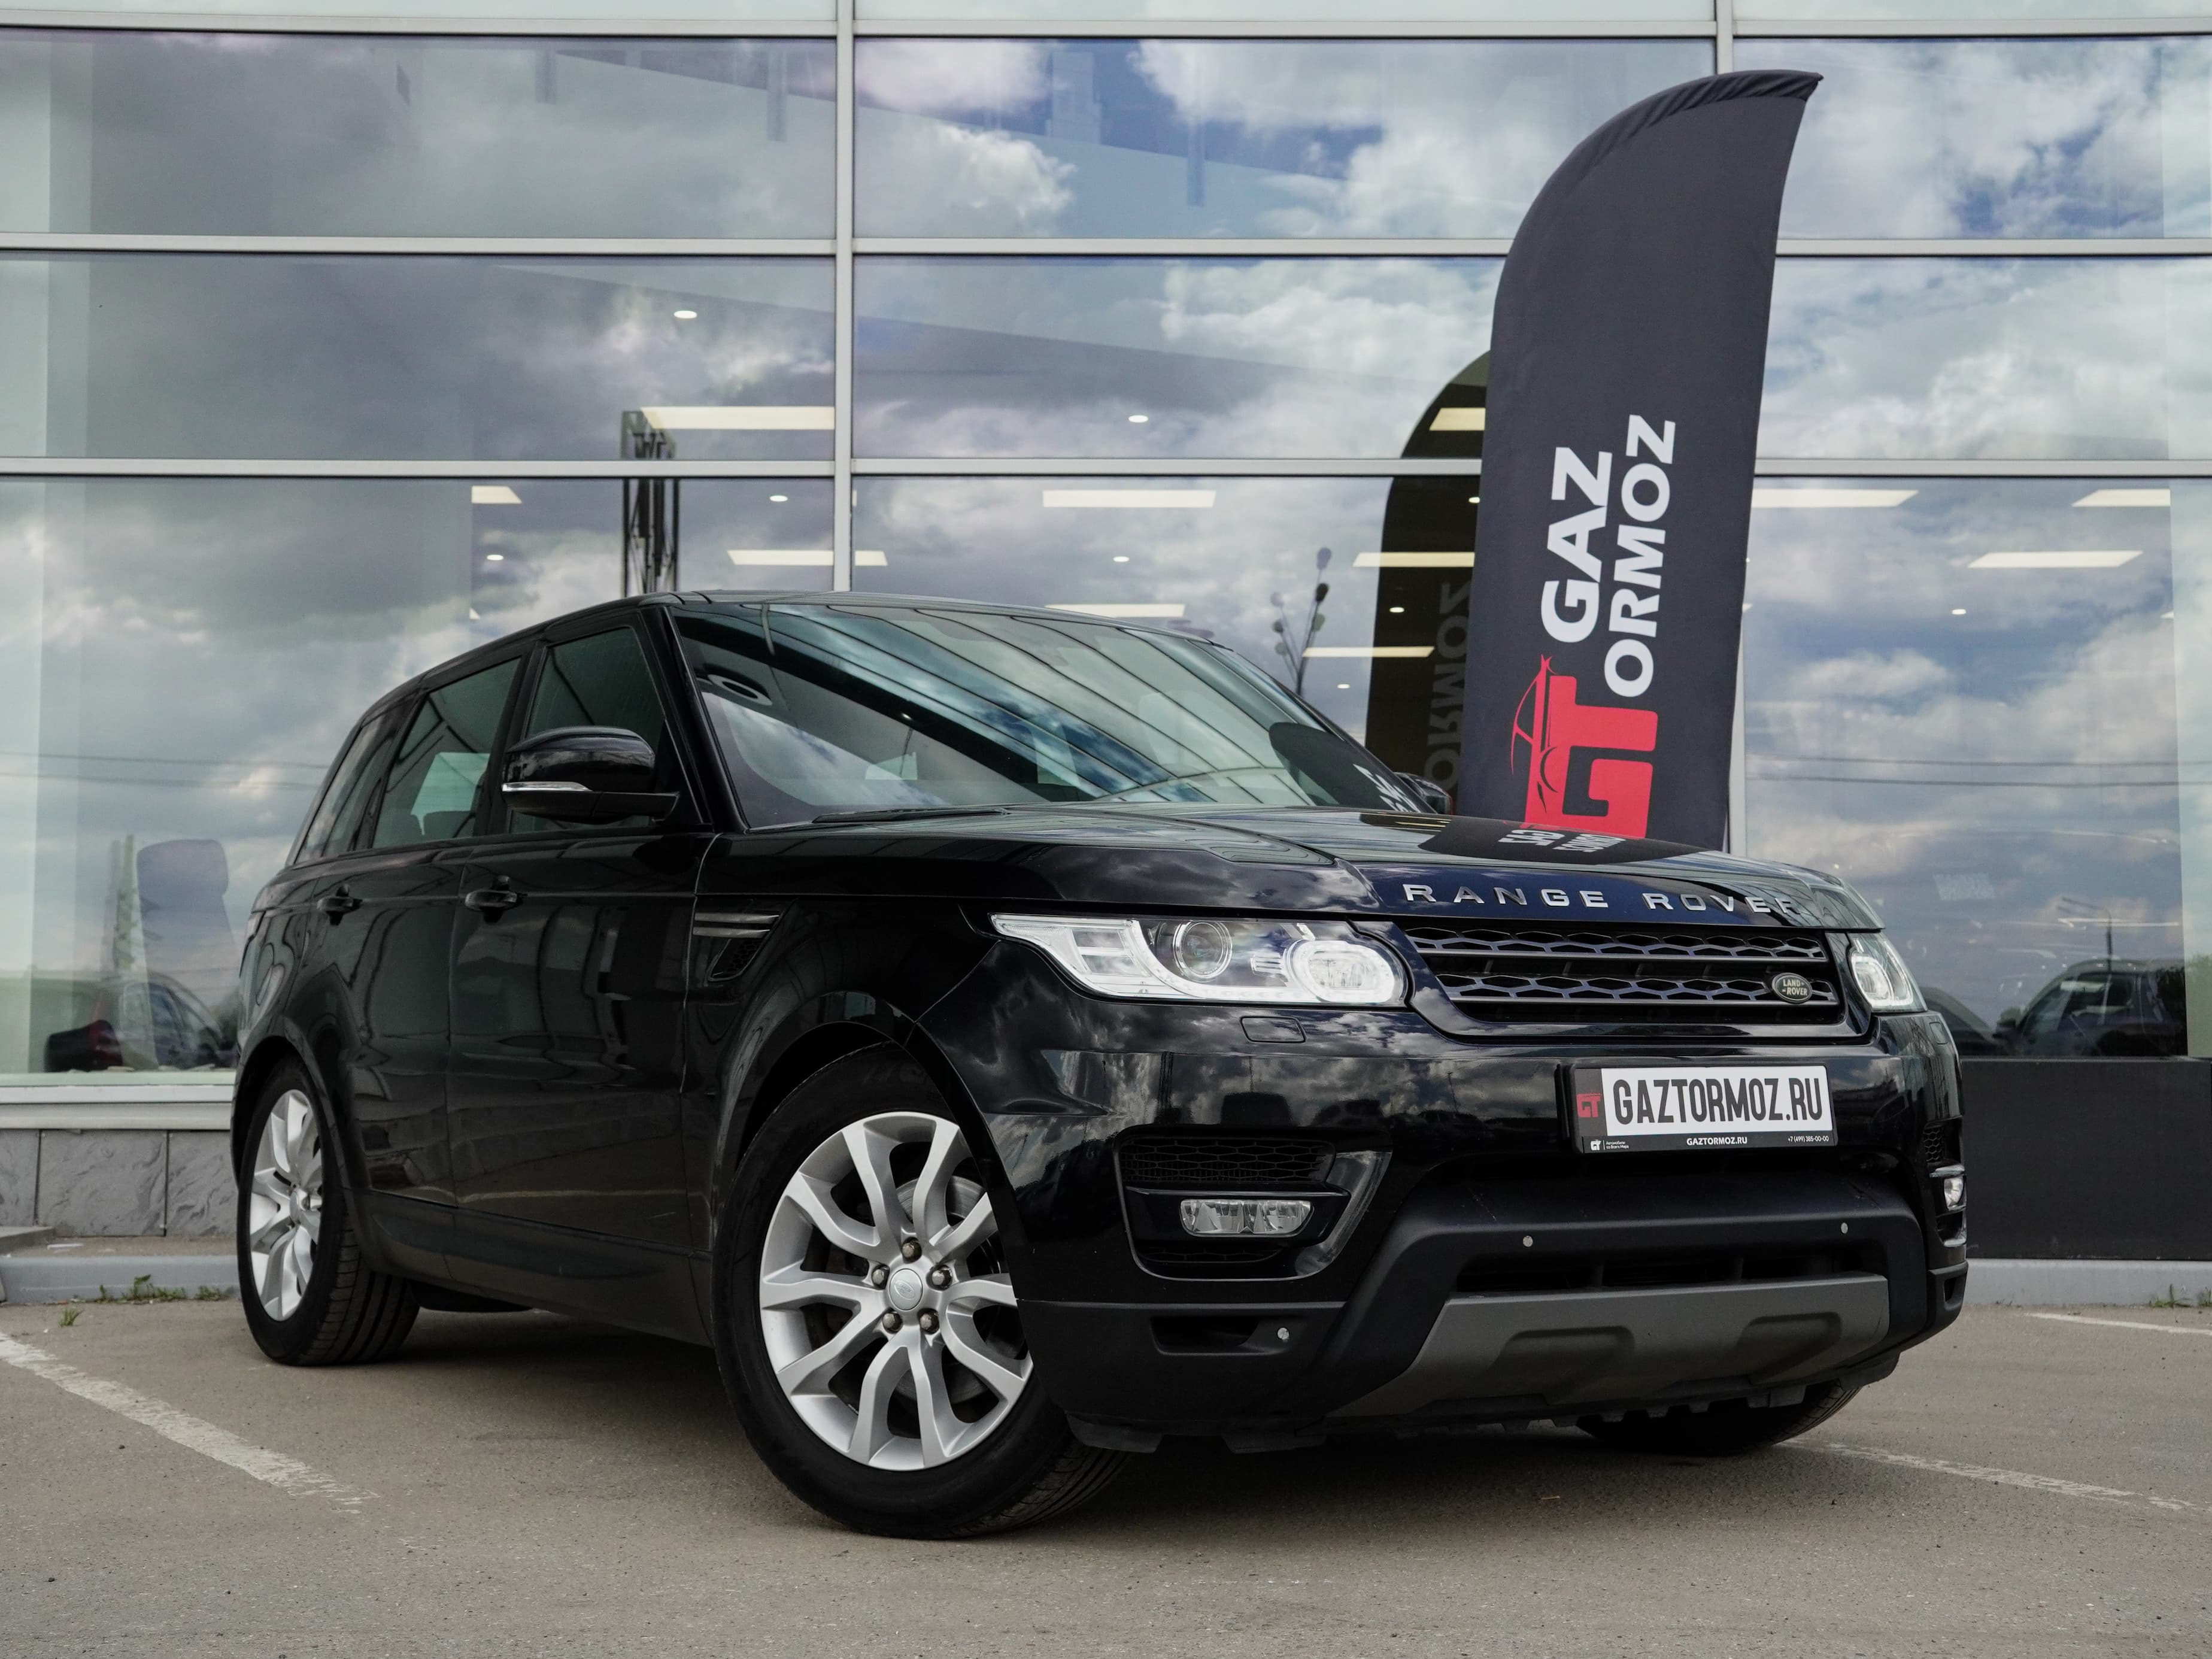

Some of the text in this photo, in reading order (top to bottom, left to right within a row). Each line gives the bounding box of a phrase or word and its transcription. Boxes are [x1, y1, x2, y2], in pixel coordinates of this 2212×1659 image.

[1541, 447, 1613, 643] GAZ
[1604, 414, 1676, 697] ORMOZ
[1403, 883, 1801, 914] RANGE ROVER
[1783, 979, 1801, 987] LAND
[1786, 987, 1807, 996] ROVER
[1613, 1078, 1823, 1126] GAZTORMOZ.RU
[1686, 1136, 1747, 1145] GAZTORMOZ.RU
